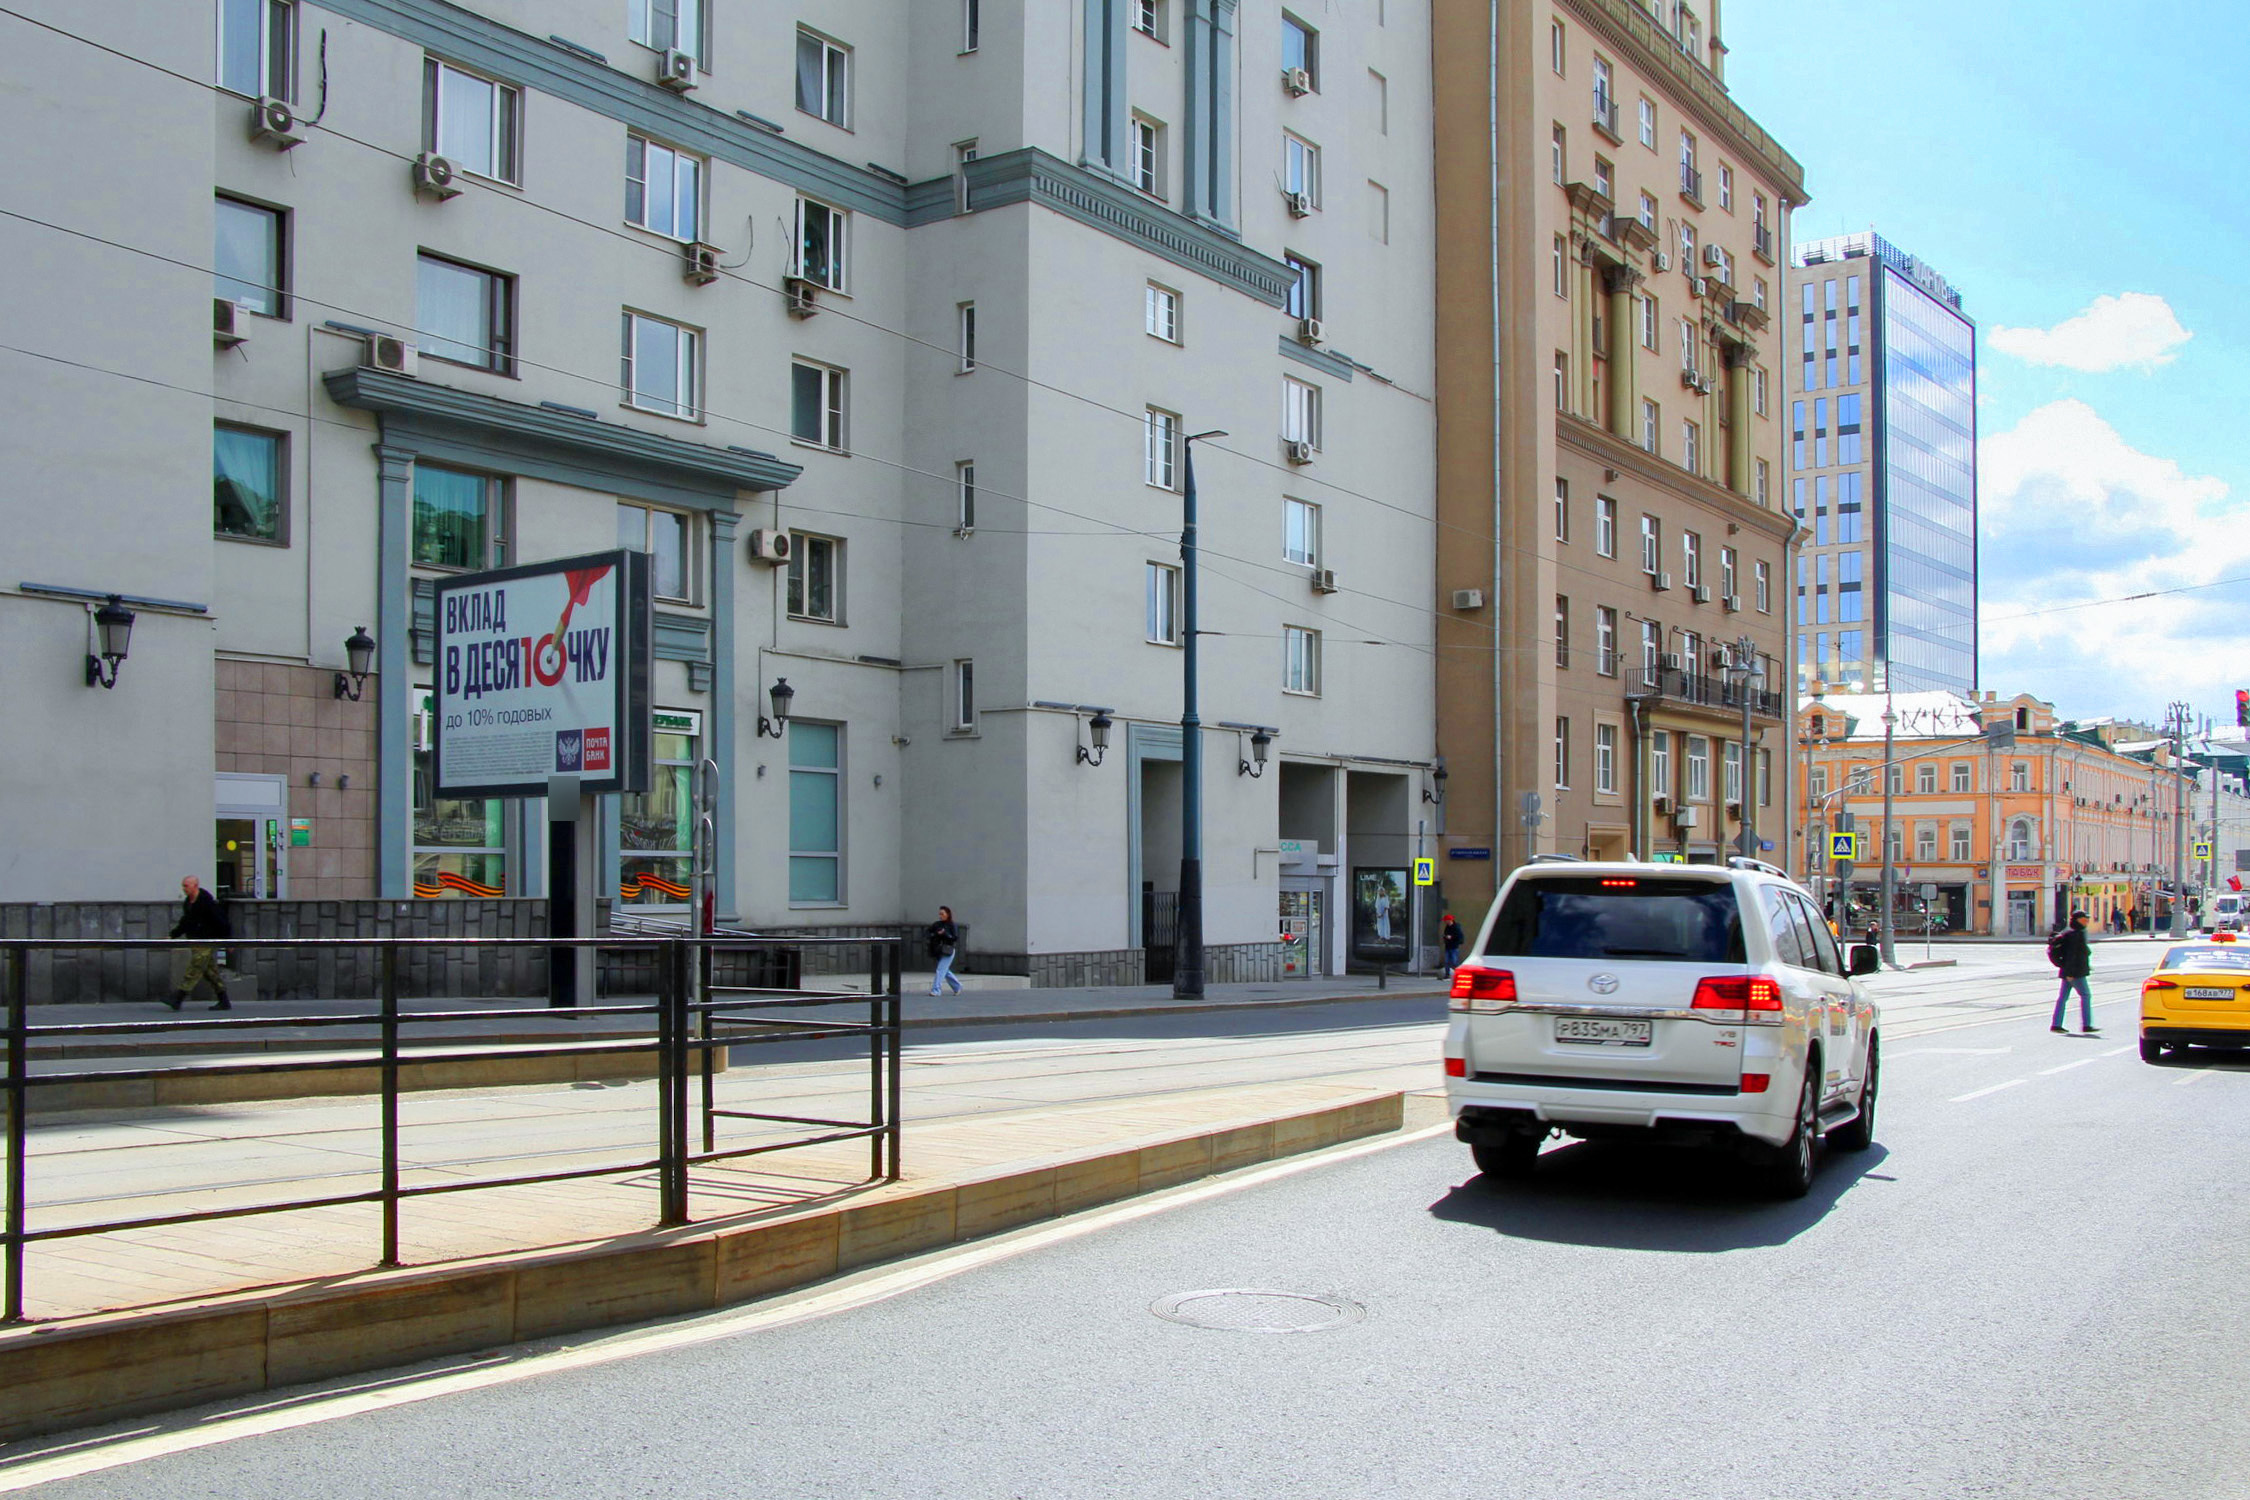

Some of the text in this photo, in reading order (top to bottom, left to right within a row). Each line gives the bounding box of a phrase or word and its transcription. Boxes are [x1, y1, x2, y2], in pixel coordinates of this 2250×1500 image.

[446, 589, 506, 634] ВКЛАД
[446, 645, 460, 695] В
[446, 707, 552, 730] до 10% годовых
[653, 714, 692, 727] ЕРБАНК
[586, 737, 608, 748] ПОЧТА
[586, 749, 606, 761] БАНК
[1280, 842, 1302, 852] ССА
[2007, 867, 2040, 877] ТАБАК
